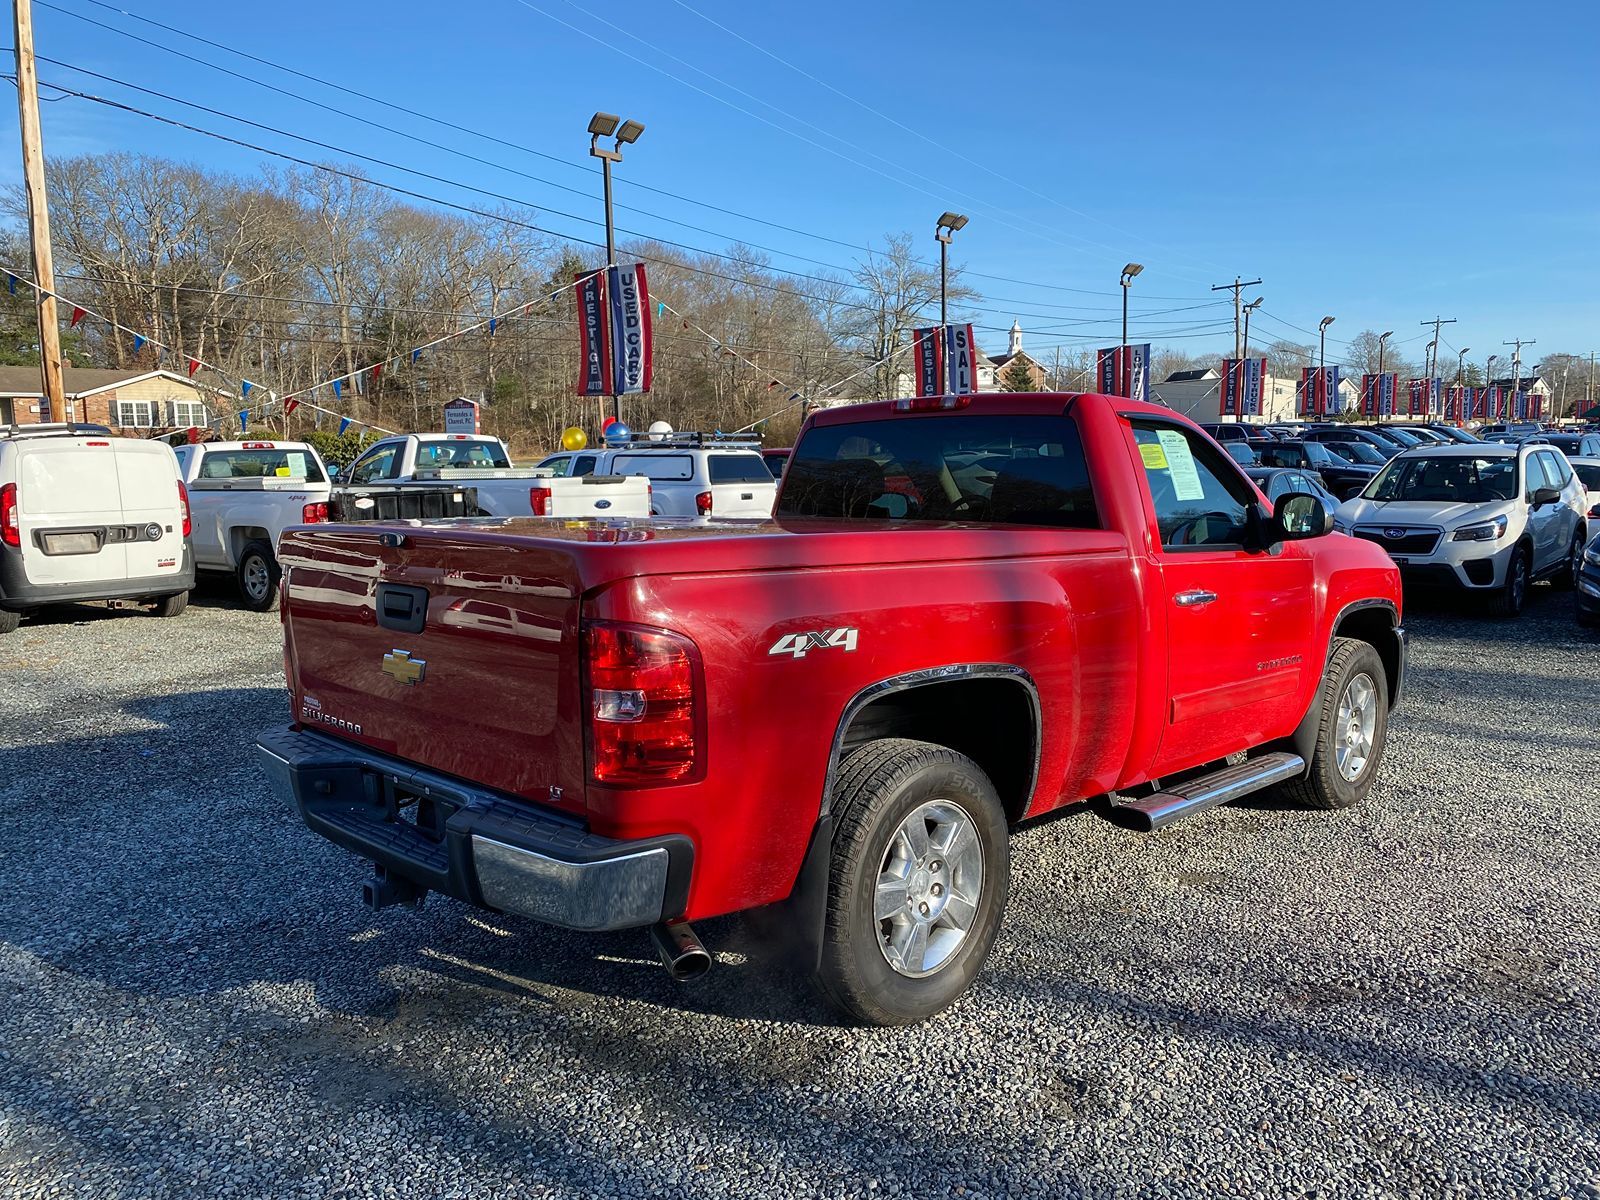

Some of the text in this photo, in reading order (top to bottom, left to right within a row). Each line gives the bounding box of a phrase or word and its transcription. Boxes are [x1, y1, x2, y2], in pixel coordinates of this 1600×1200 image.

[584, 278, 599, 375] PRESTIGE
[621, 273, 642, 386] USED CARS
[1133, 350, 1142, 368] LOW
[1104, 352, 1113, 396] RESTI
[1249, 383, 1259, 412] TRUCKS
[302, 706, 362, 735] SILVERADO
[549, 785, 564, 800] LT
[950, 773, 986, 801] SRX
